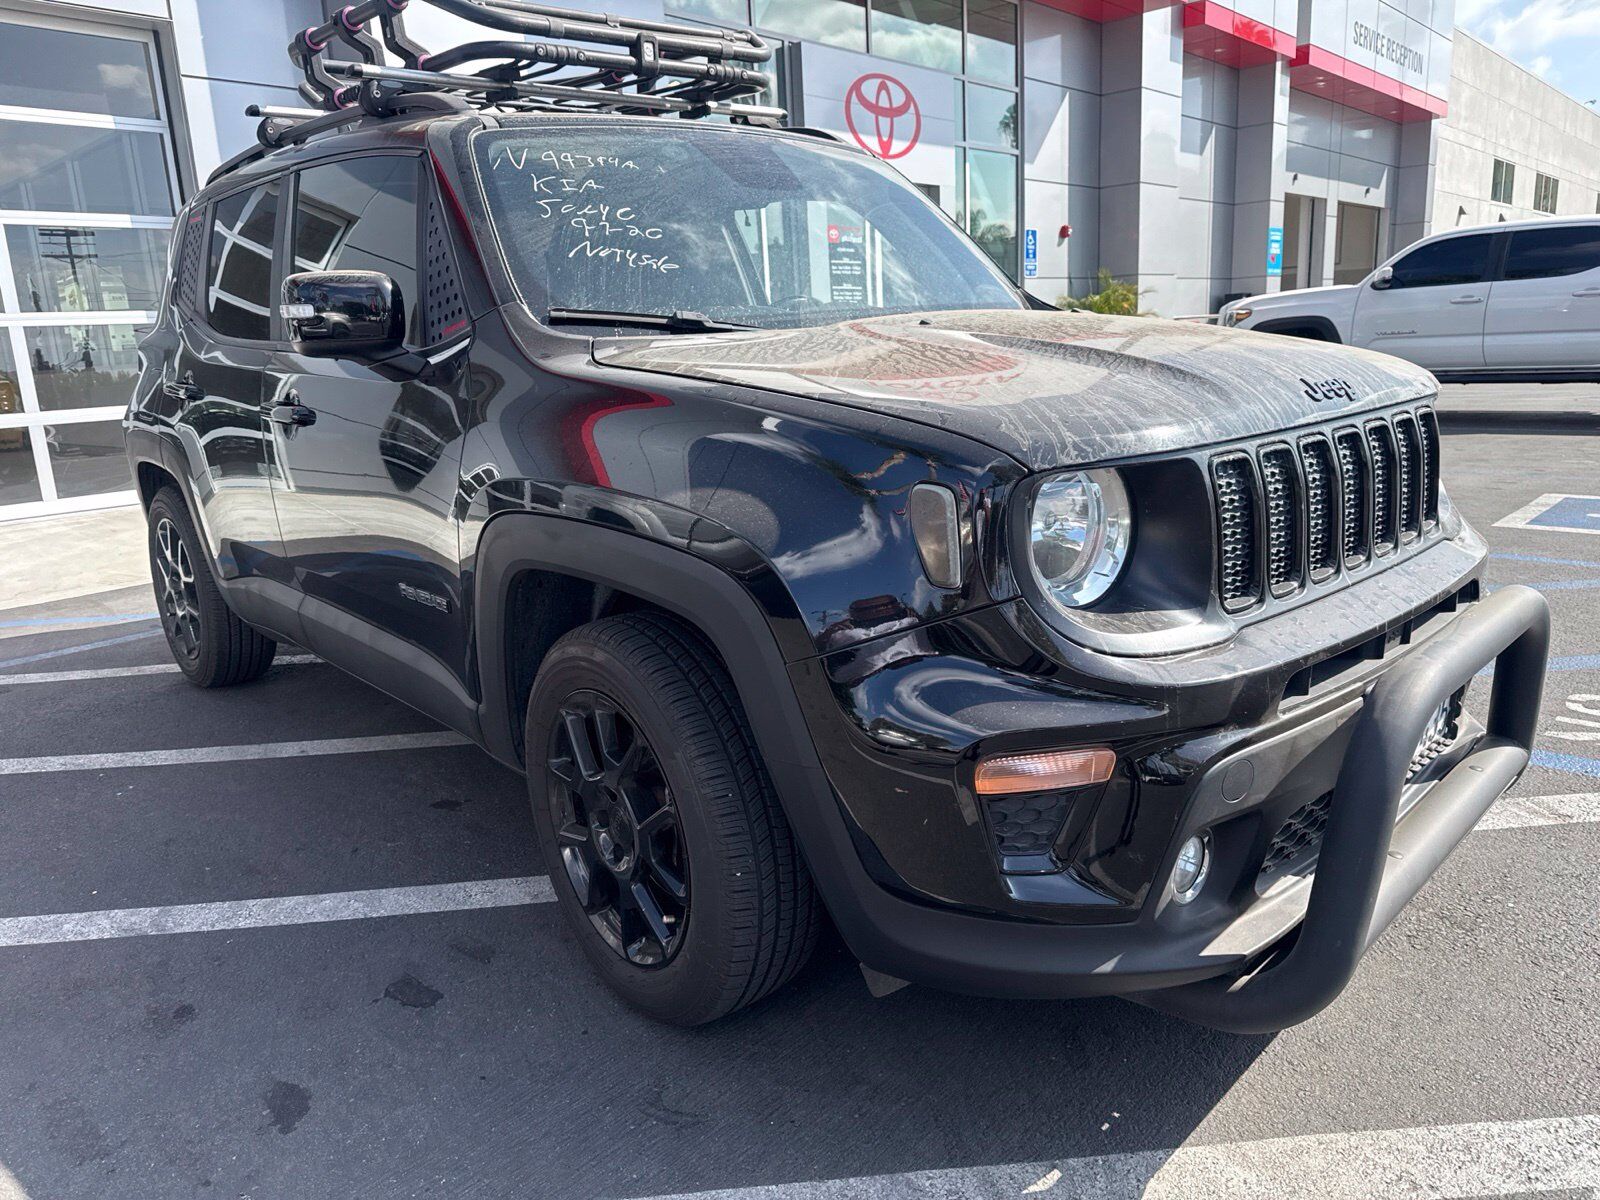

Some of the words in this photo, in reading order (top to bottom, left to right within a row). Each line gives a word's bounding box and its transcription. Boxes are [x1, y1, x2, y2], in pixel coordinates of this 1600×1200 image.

[1353, 21, 1385, 57] SERVICE
[1386, 38, 1424, 75] RECEPTION
[531, 173, 605, 194] KIA
[1299, 378, 1356, 402] Jeep
